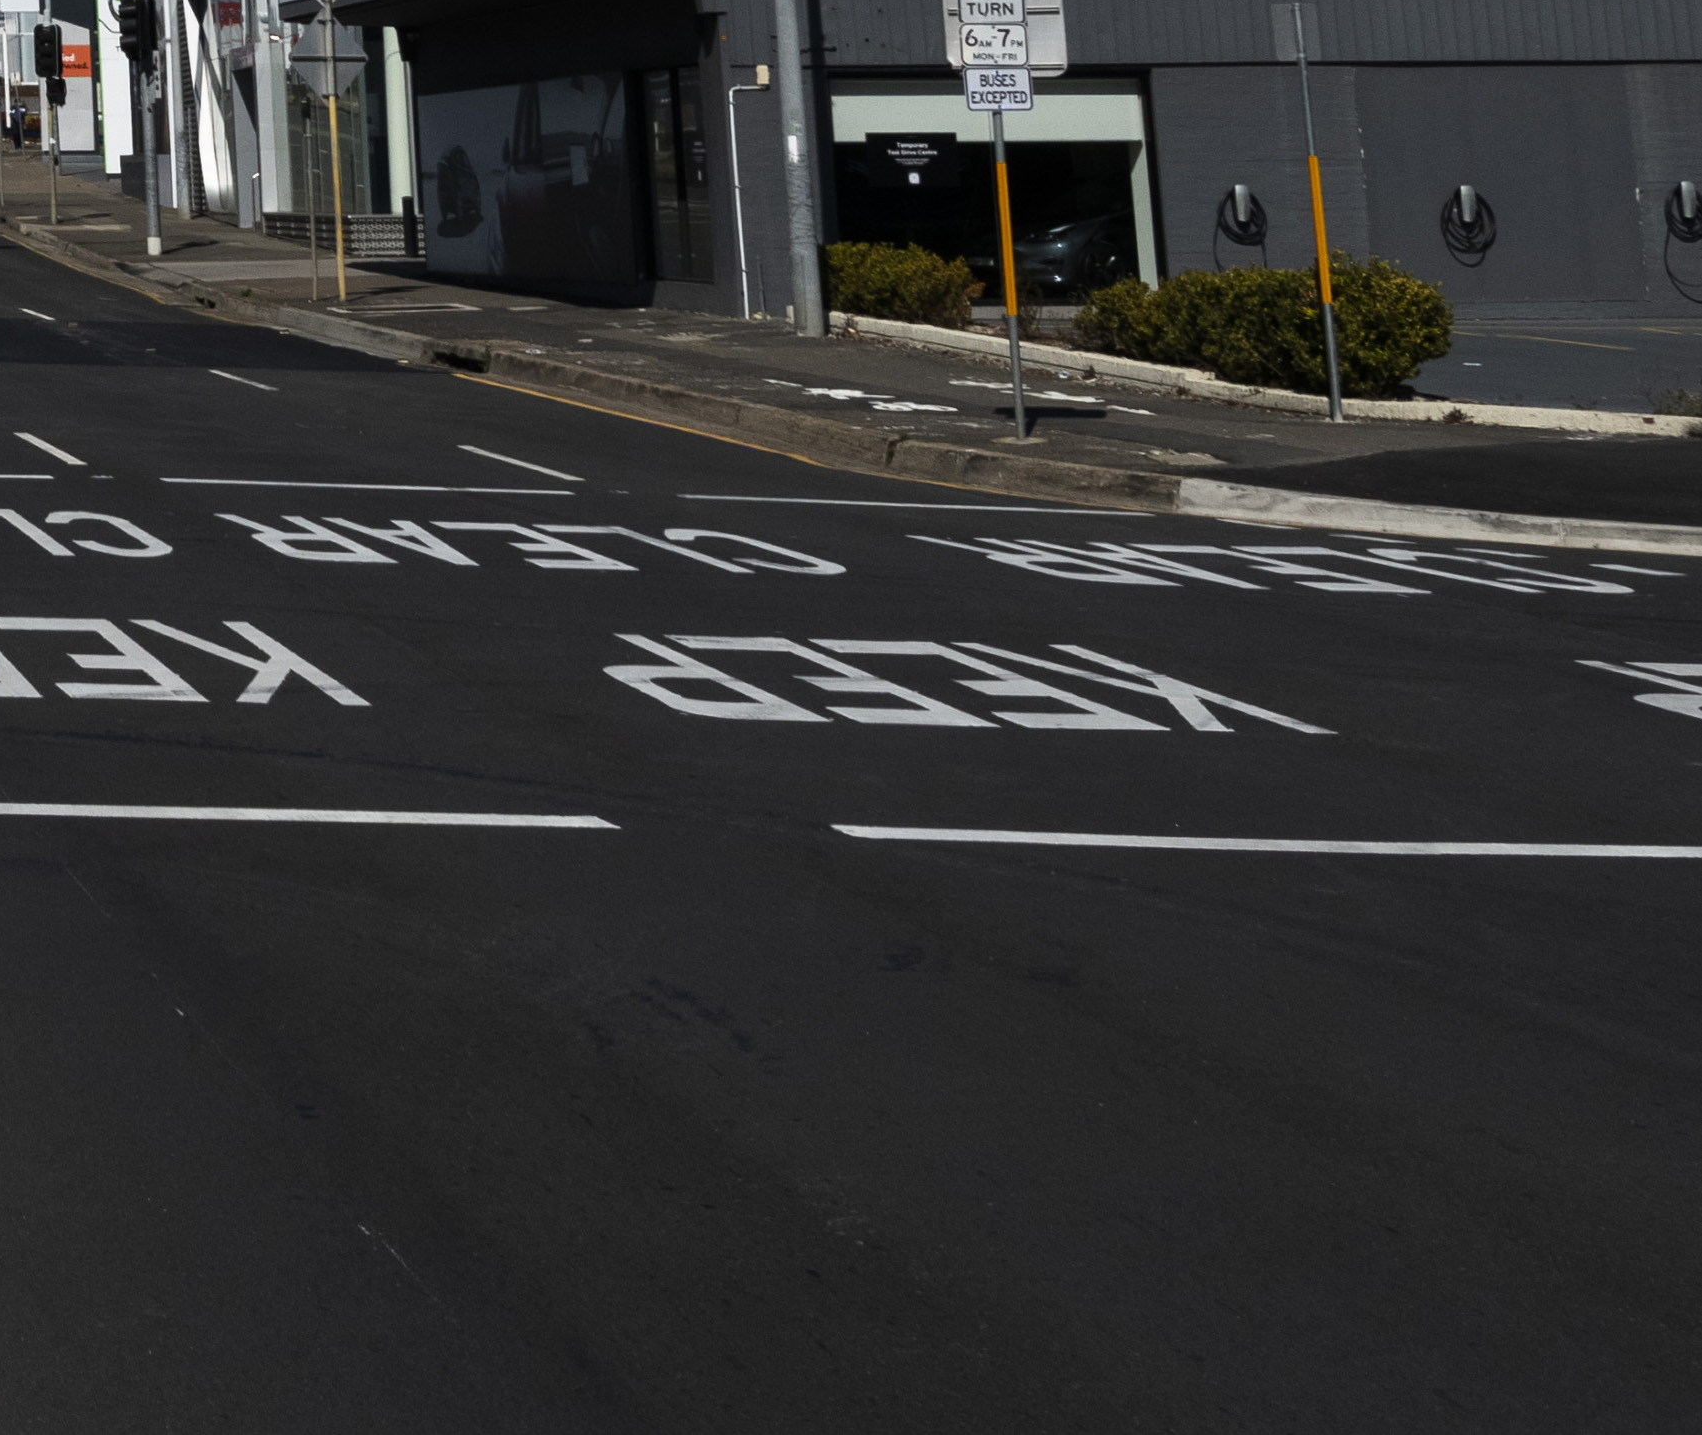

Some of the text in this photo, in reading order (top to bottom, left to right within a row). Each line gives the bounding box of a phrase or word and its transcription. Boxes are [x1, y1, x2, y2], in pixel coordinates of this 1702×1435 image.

[967, 2, 1014, 16] TURN
[980, 74, 1016, 87] BUSES
[971, 91, 1028, 104] EXCEPTED
[896, 141, 929, 149] Temporary
[212, 512, 847, 576] CLEAR
[904, 534, 1635, 595] CLEAR
[601, 633, 1338, 735] KEEP
